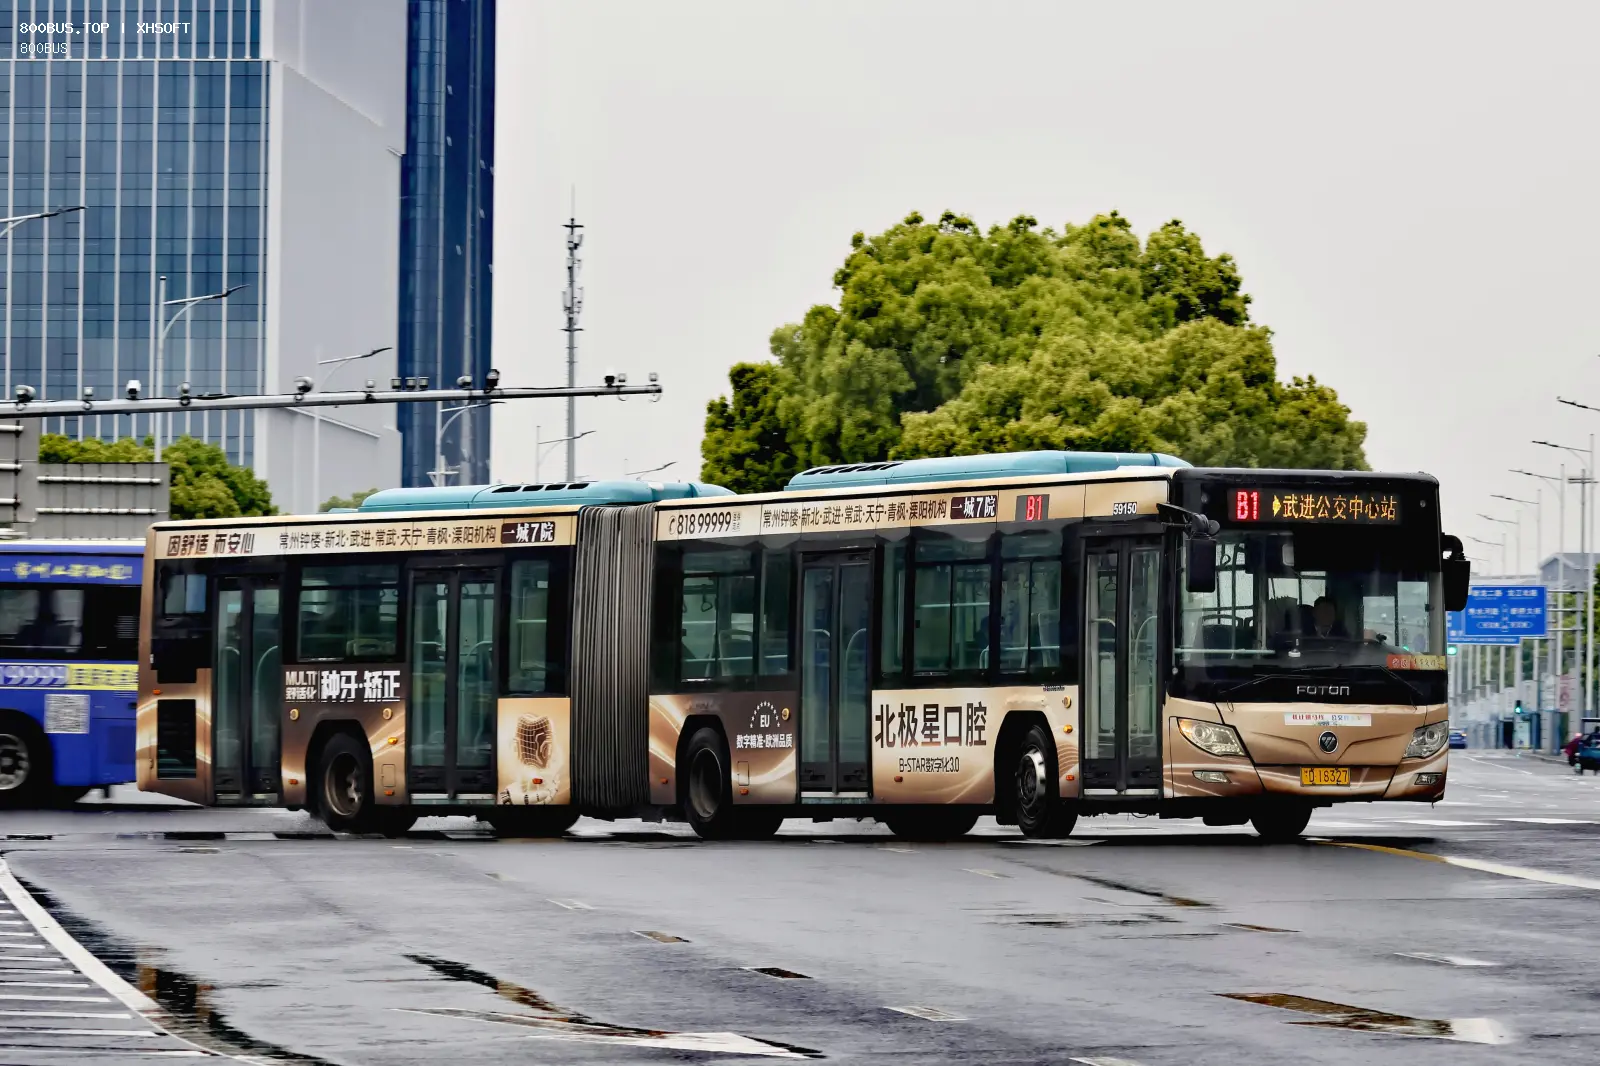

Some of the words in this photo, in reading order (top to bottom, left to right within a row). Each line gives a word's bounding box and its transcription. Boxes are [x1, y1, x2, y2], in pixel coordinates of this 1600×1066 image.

[951, 496, 996, 518] 一城7院
[1026, 495, 1043, 521] B1
[1113, 502, 1138, 515] 59150
[1237, 491, 1260, 520] B1
[1282, 493, 1398, 521] 武进公交中心站
[502, 522, 555, 543] 一城7院
[677, 514, 695, 535] 818
[697, 511, 732, 534] 99999
[167, 534, 209, 556] 因舒适
[213, 532, 255, 555] 而安心
[285, 671, 317, 685] MULTI
[321, 670, 400, 702] 种牙·矫正
[1297, 685, 1350, 696] FOTON
[760, 714, 770, 728] EU
[874, 701, 987, 748] 北极星口腔
[736, 734, 793, 749] 数字精准·欧洲品质
[899, 756, 960, 773] B-STAR数字化3.0
